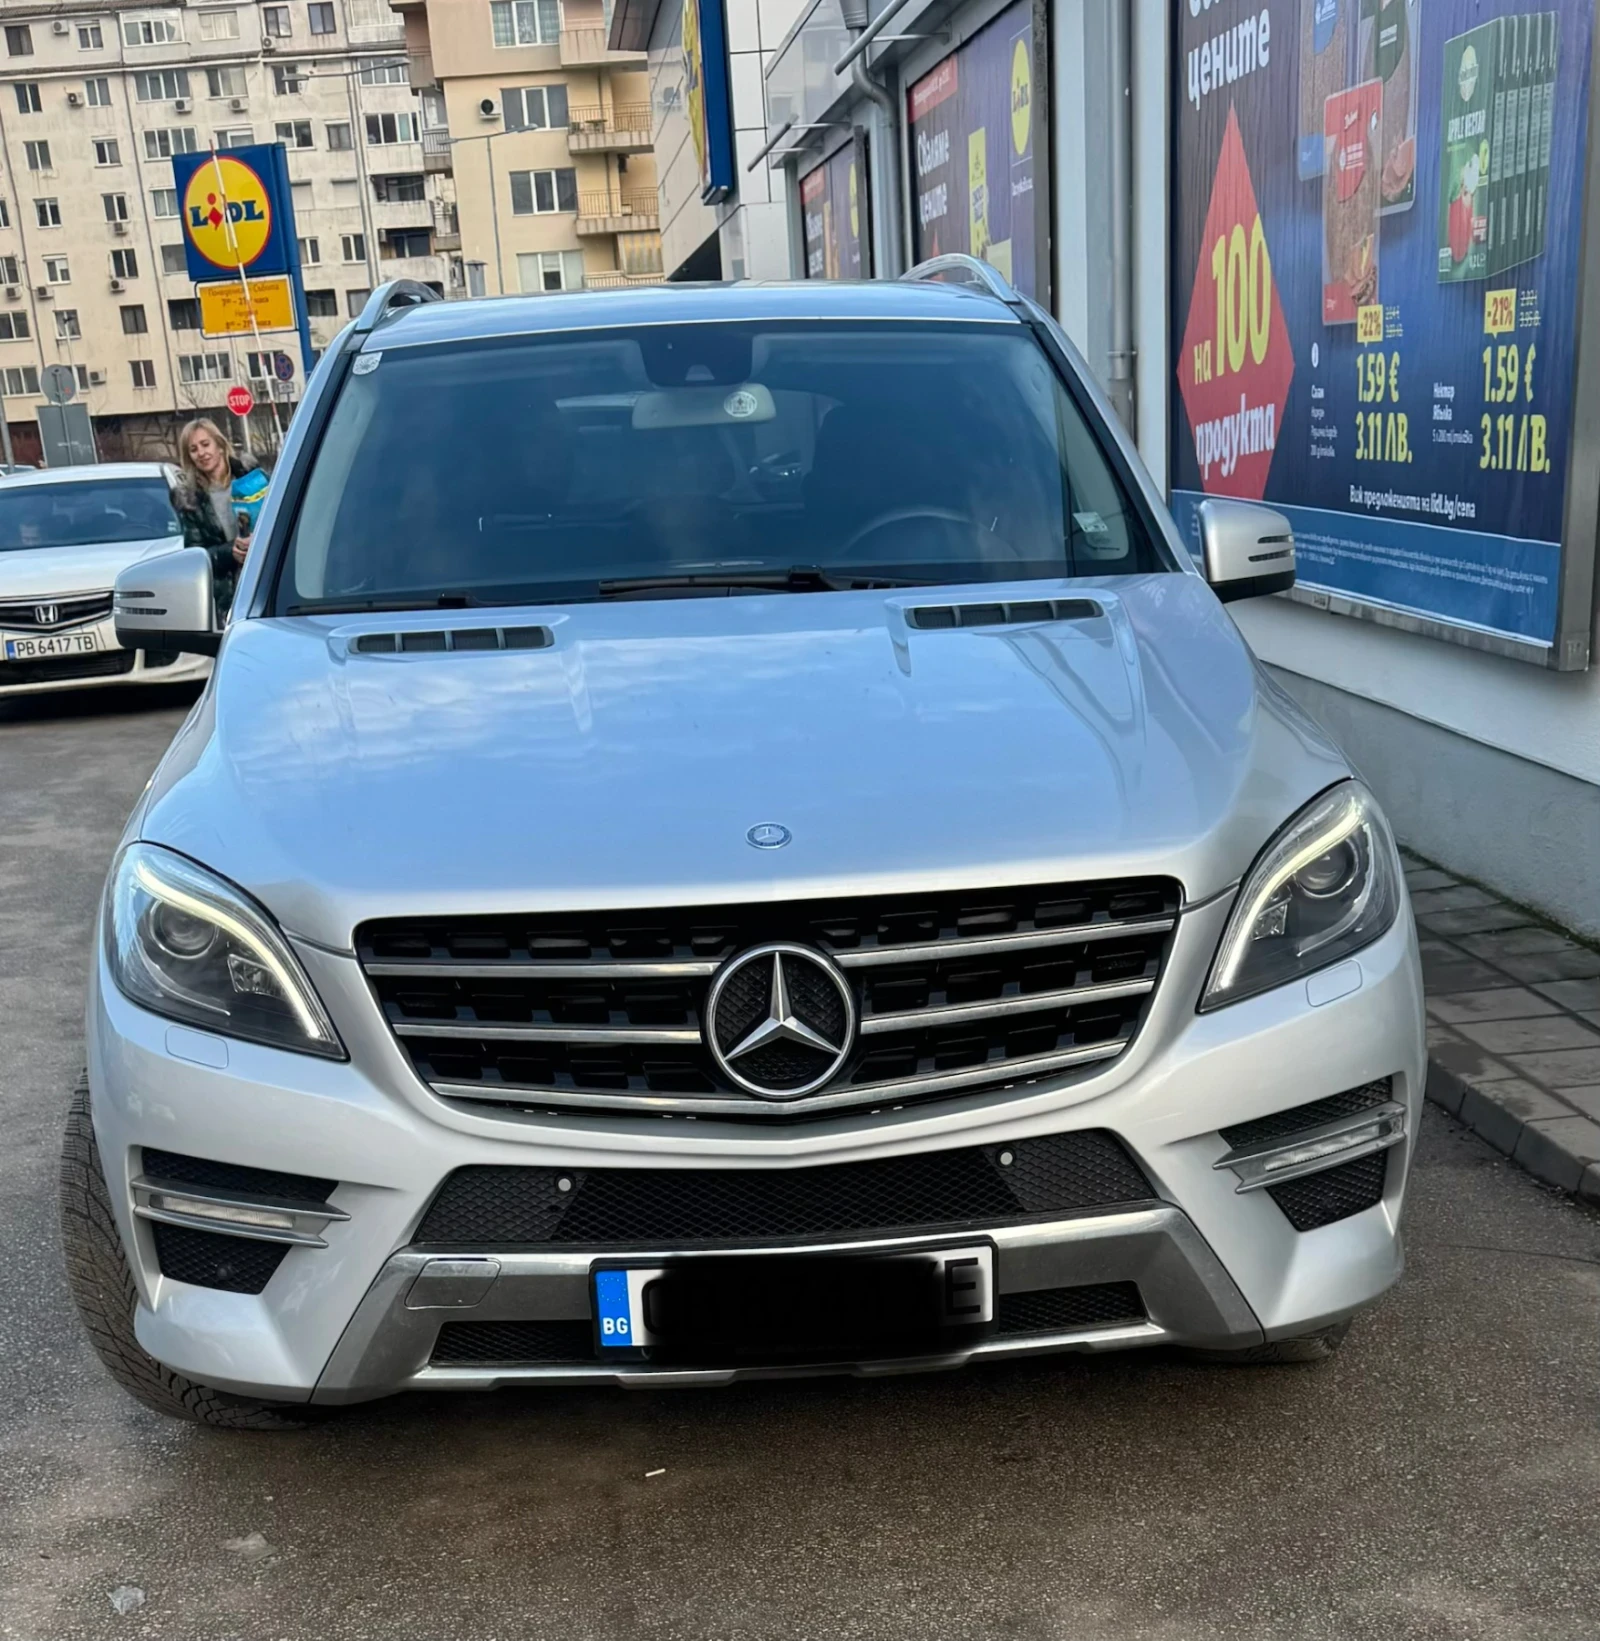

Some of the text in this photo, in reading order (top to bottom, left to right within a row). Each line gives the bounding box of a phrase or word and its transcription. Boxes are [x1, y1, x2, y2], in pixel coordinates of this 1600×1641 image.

[1188, 9, 1270, 111] цените
[189, 192, 265, 231] LIDL
[1212, 212, 1271, 377] 100
[1487, 294, 1513, 327] -21%
[1360, 311, 1381, 337] -22%
[1357, 351, 1400, 403] 1.59 €
[1483, 342, 1536, 403] 1.59 €
[230, 394, 250, 407] STOP
[1196, 393, 1275, 480] продукта
[1355, 411, 1382, 461] 3.11
[1480, 413, 1514, 470] 3.11
[16, 641, 36, 657] PB
[38, 638, 71, 655] 6417
[75, 635, 94, 651] TB
[603, 1317, 628, 1336] BG
